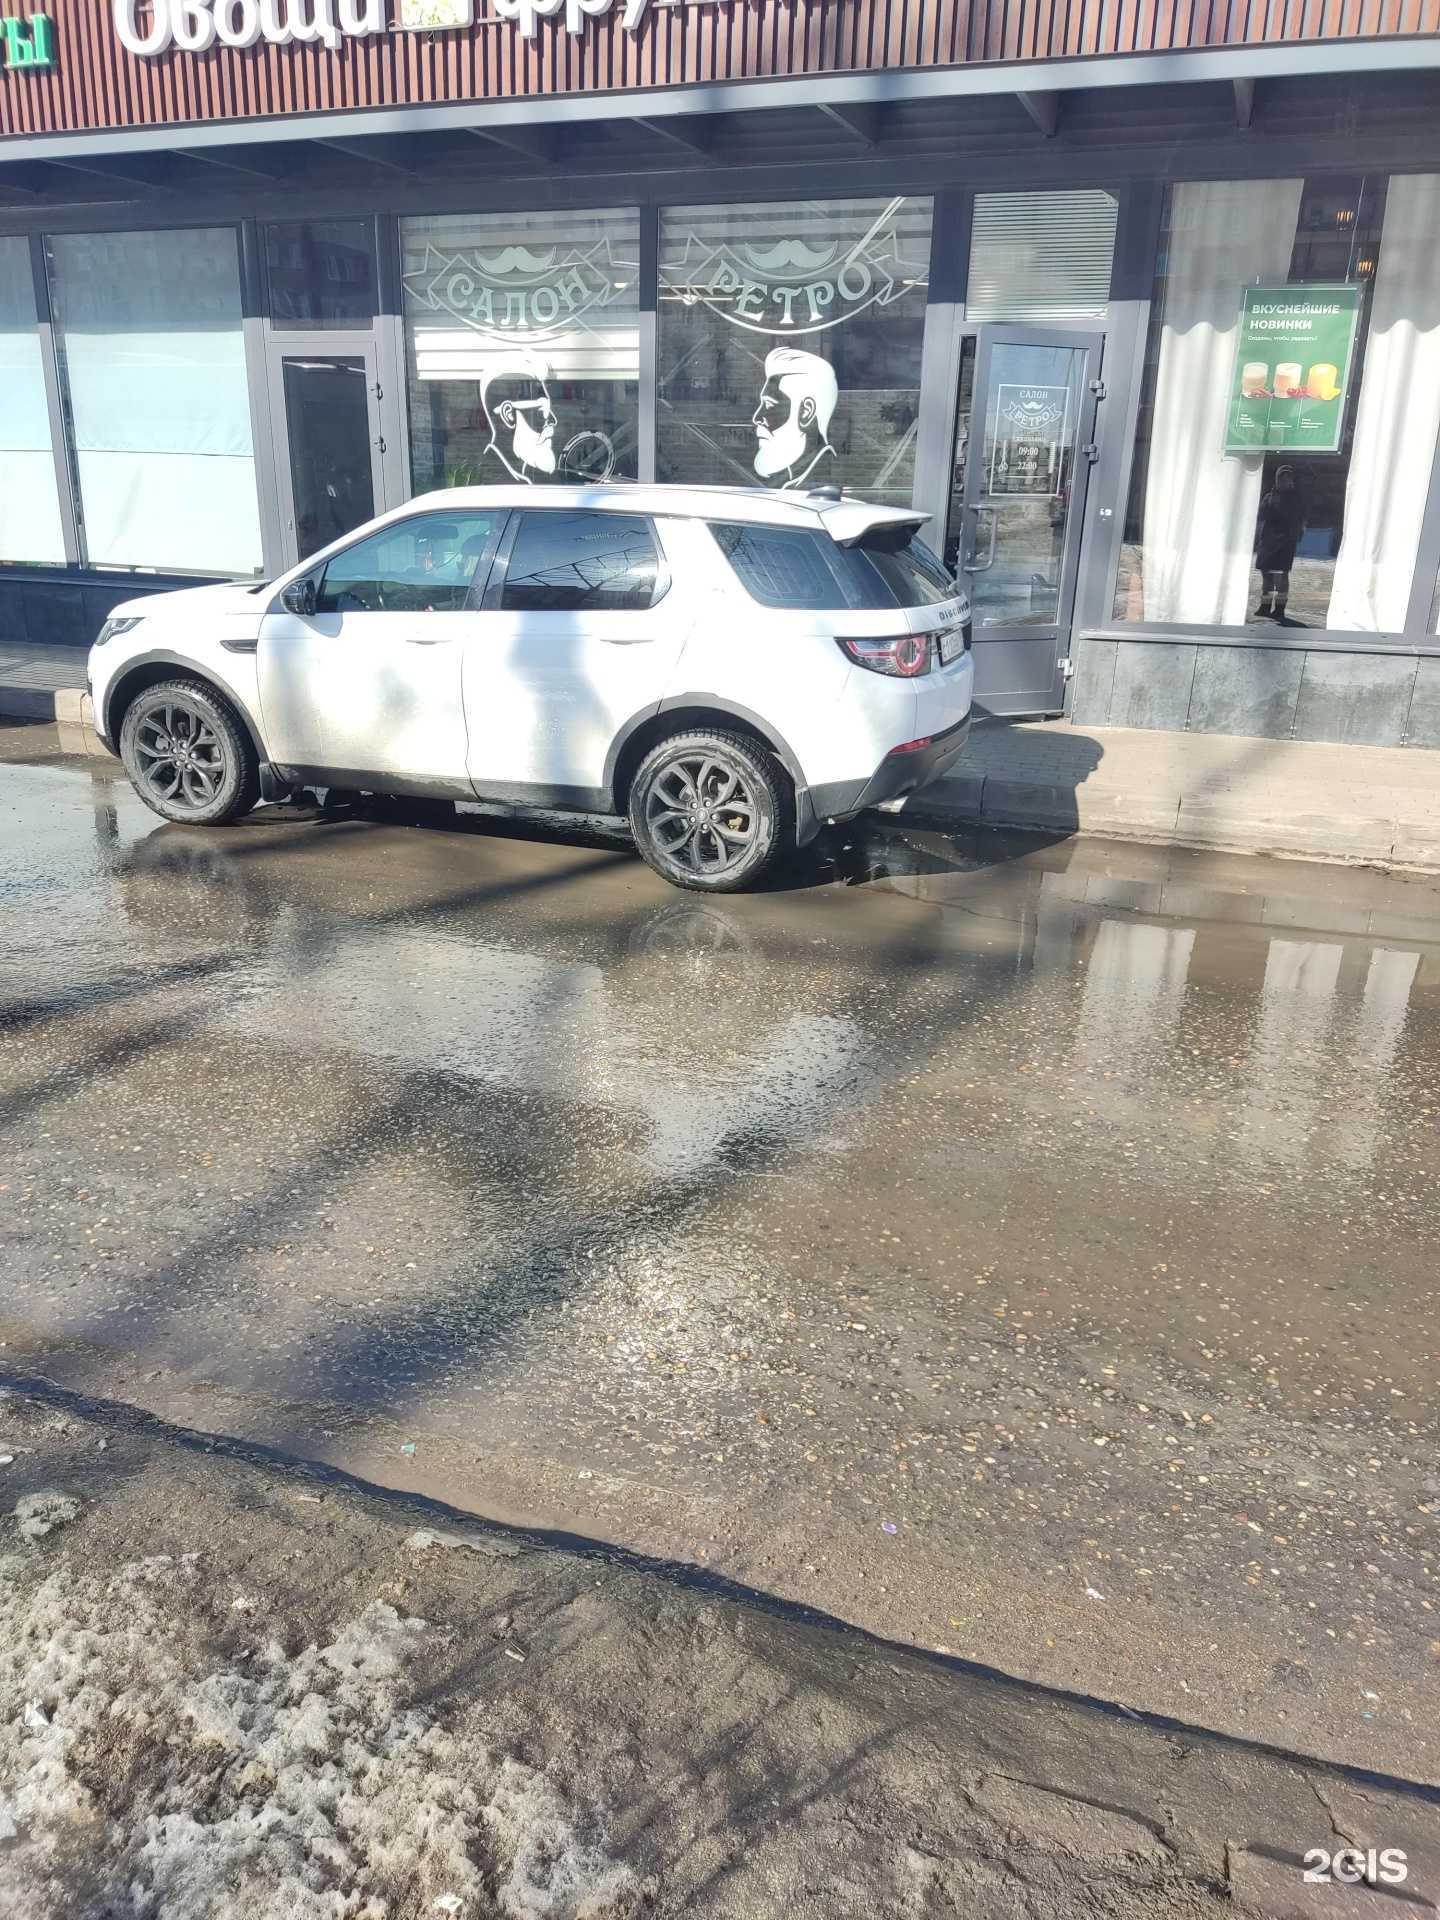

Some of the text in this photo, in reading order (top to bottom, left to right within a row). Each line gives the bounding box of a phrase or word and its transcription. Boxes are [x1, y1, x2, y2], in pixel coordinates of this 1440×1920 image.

[0, 13, 53, 68] Ы
[447, 266, 592, 326] САЛОН
[706, 259, 872, 325] РЕТРО
[1252, 302, 1341, 314] ВКУСНЕЙШИЕ
[1250, 319, 1313, 330] НОВИНКИ
[1019, 390, 1048, 399] САЛОН
[1014, 409, 1050, 427] РЕТРО
